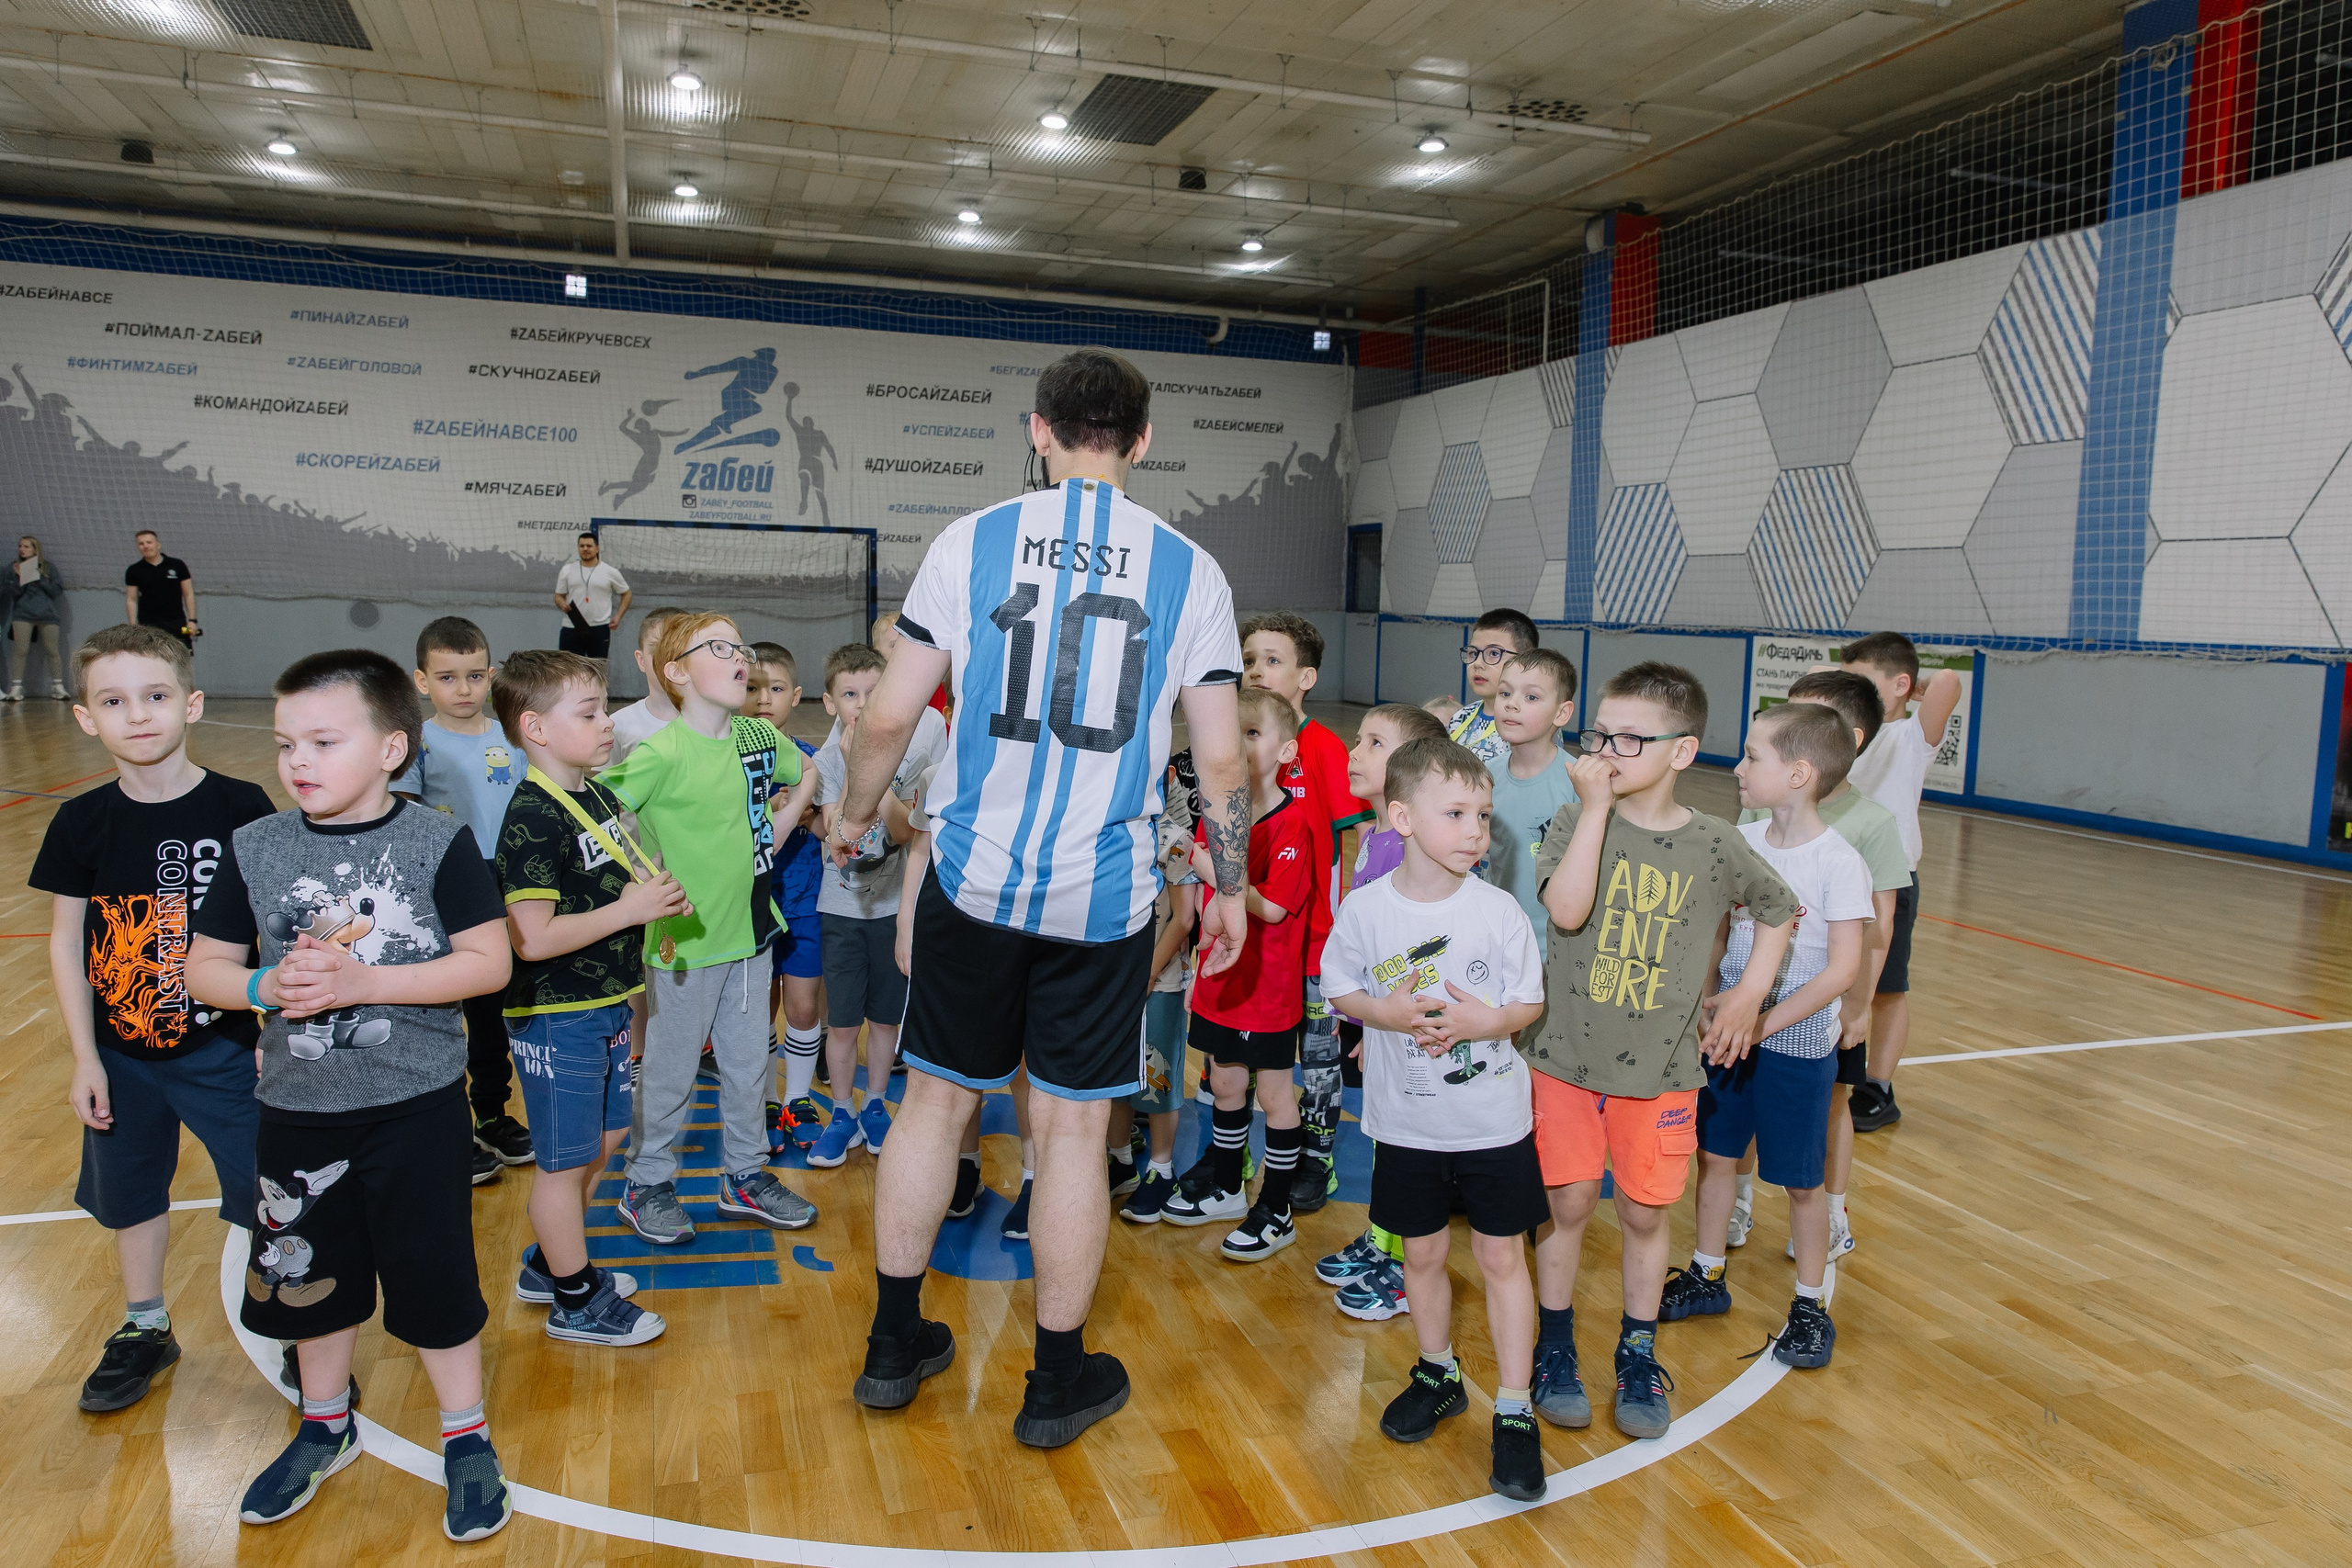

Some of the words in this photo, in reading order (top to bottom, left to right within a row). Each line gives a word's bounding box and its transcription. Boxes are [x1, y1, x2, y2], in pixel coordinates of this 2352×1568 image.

[1023, 535, 1131, 580] MESSI
[989, 581, 1151, 754] 10
[157, 840, 188, 1011] CONTRAST
[1595, 956, 1621, 974] WILD
[1593, 968, 1615, 987] FOR
[1590, 983, 1613, 999] EST
[1416, 1371, 1441, 1389] SPORT
[1501, 1418, 1532, 1431] SPORT
